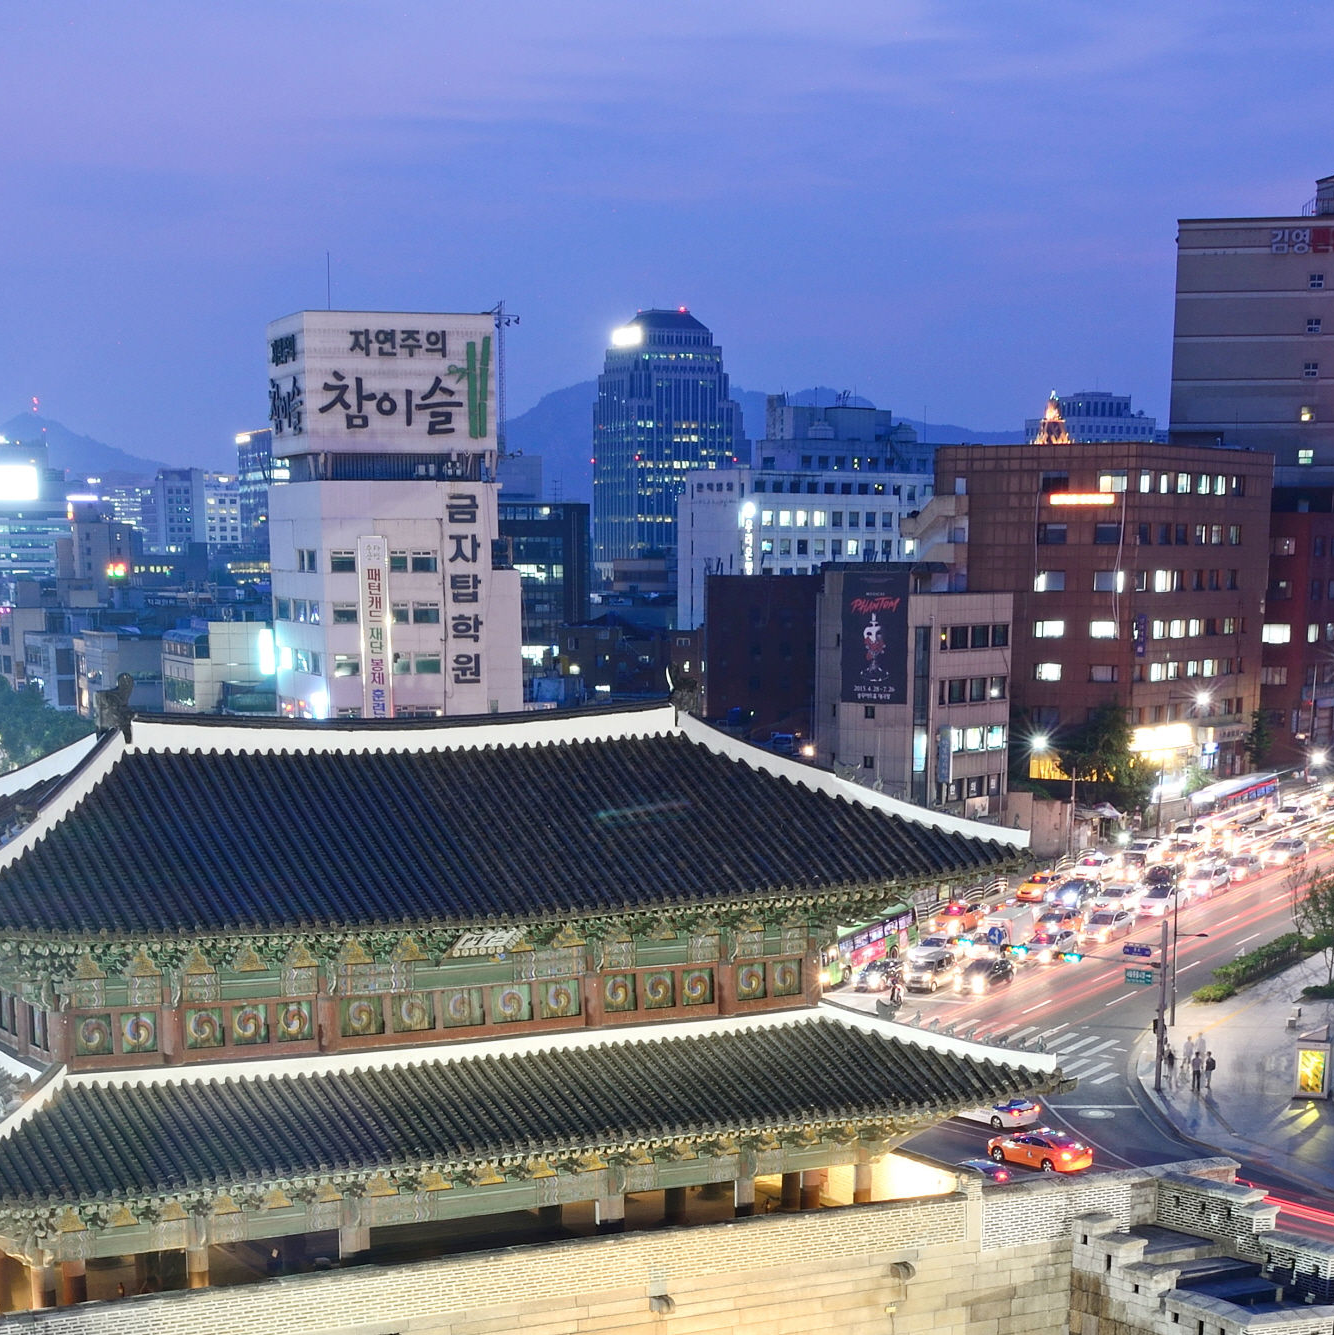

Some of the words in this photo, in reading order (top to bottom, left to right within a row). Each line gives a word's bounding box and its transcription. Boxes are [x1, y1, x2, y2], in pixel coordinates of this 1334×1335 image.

[350, 329, 447, 358] 자연주의
[318, 370, 464, 436] 참이슬
[367, 568, 382, 623] 패턴캐드
[445, 493, 483, 684] 금자탑학원
[850, 597, 900, 614] PHANTOM
[369, 627, 383, 654] 재단
[370, 658, 385, 685] 봉제
[372, 689, 385, 718] 훈련
